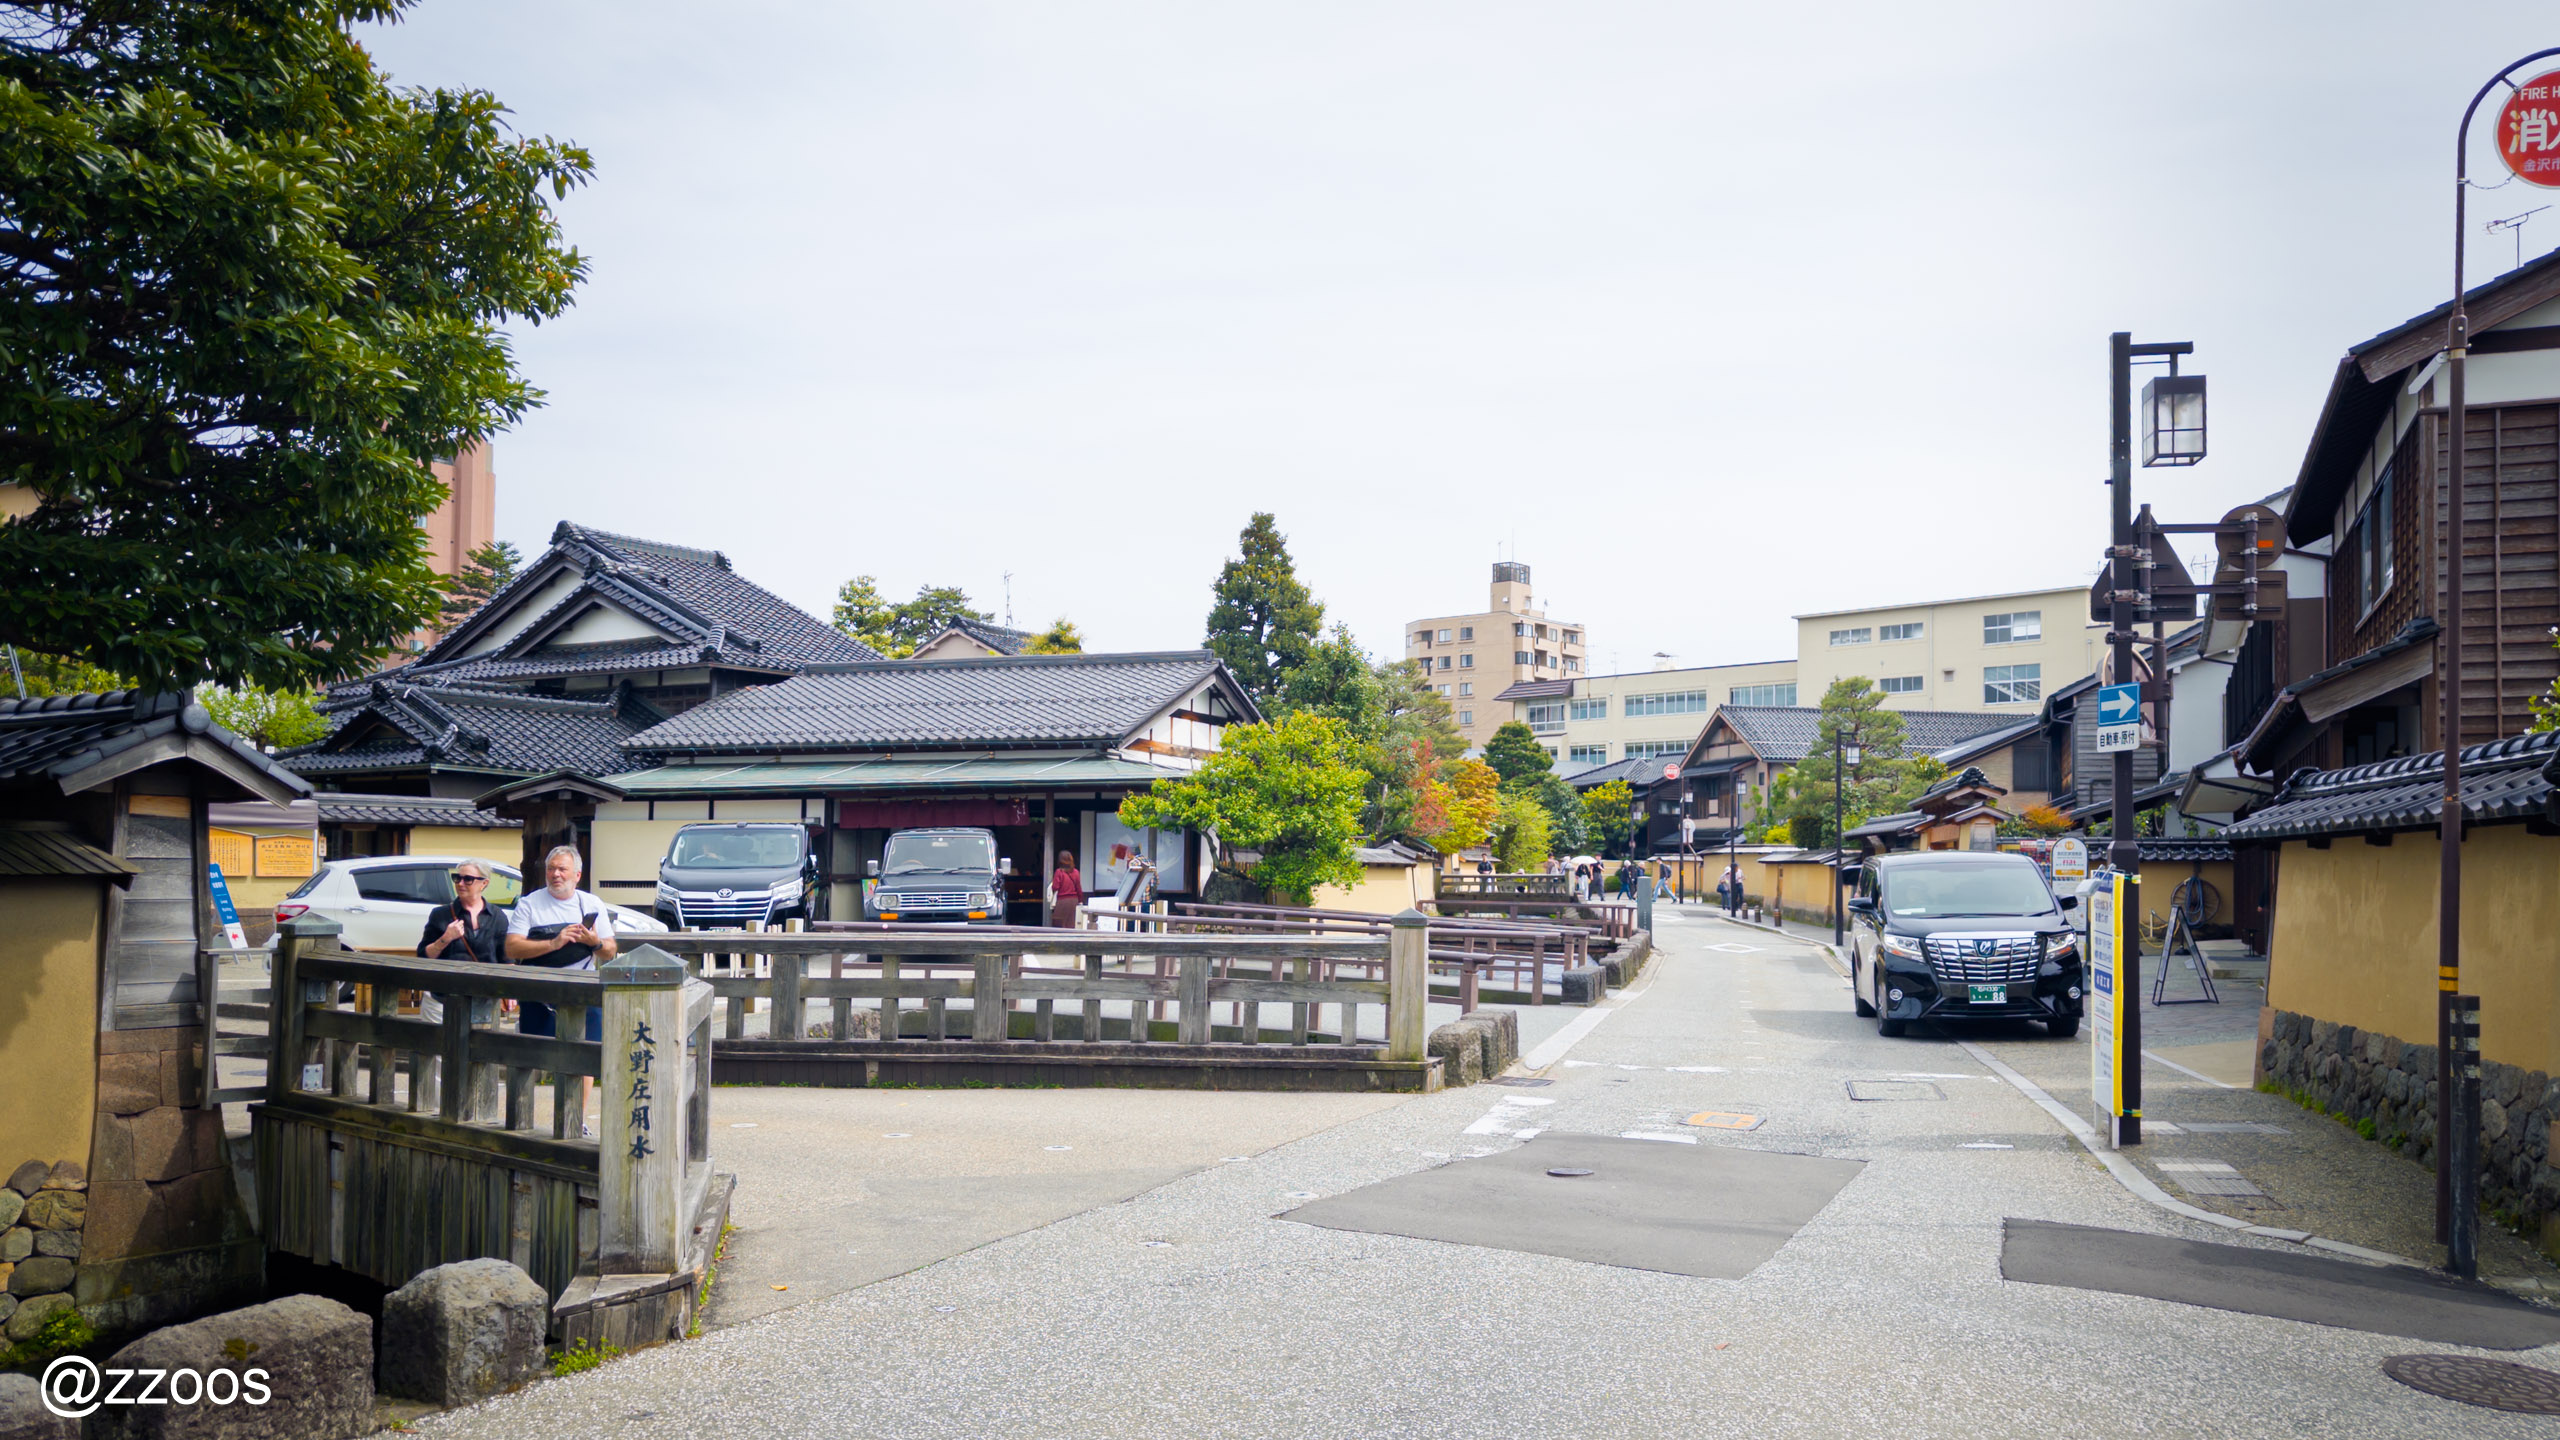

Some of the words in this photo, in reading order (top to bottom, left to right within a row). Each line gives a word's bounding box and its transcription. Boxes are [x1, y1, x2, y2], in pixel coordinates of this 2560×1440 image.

[2520, 86, 2548, 101] FIRE
[627, 1021, 656, 1160] 大野庄用水
